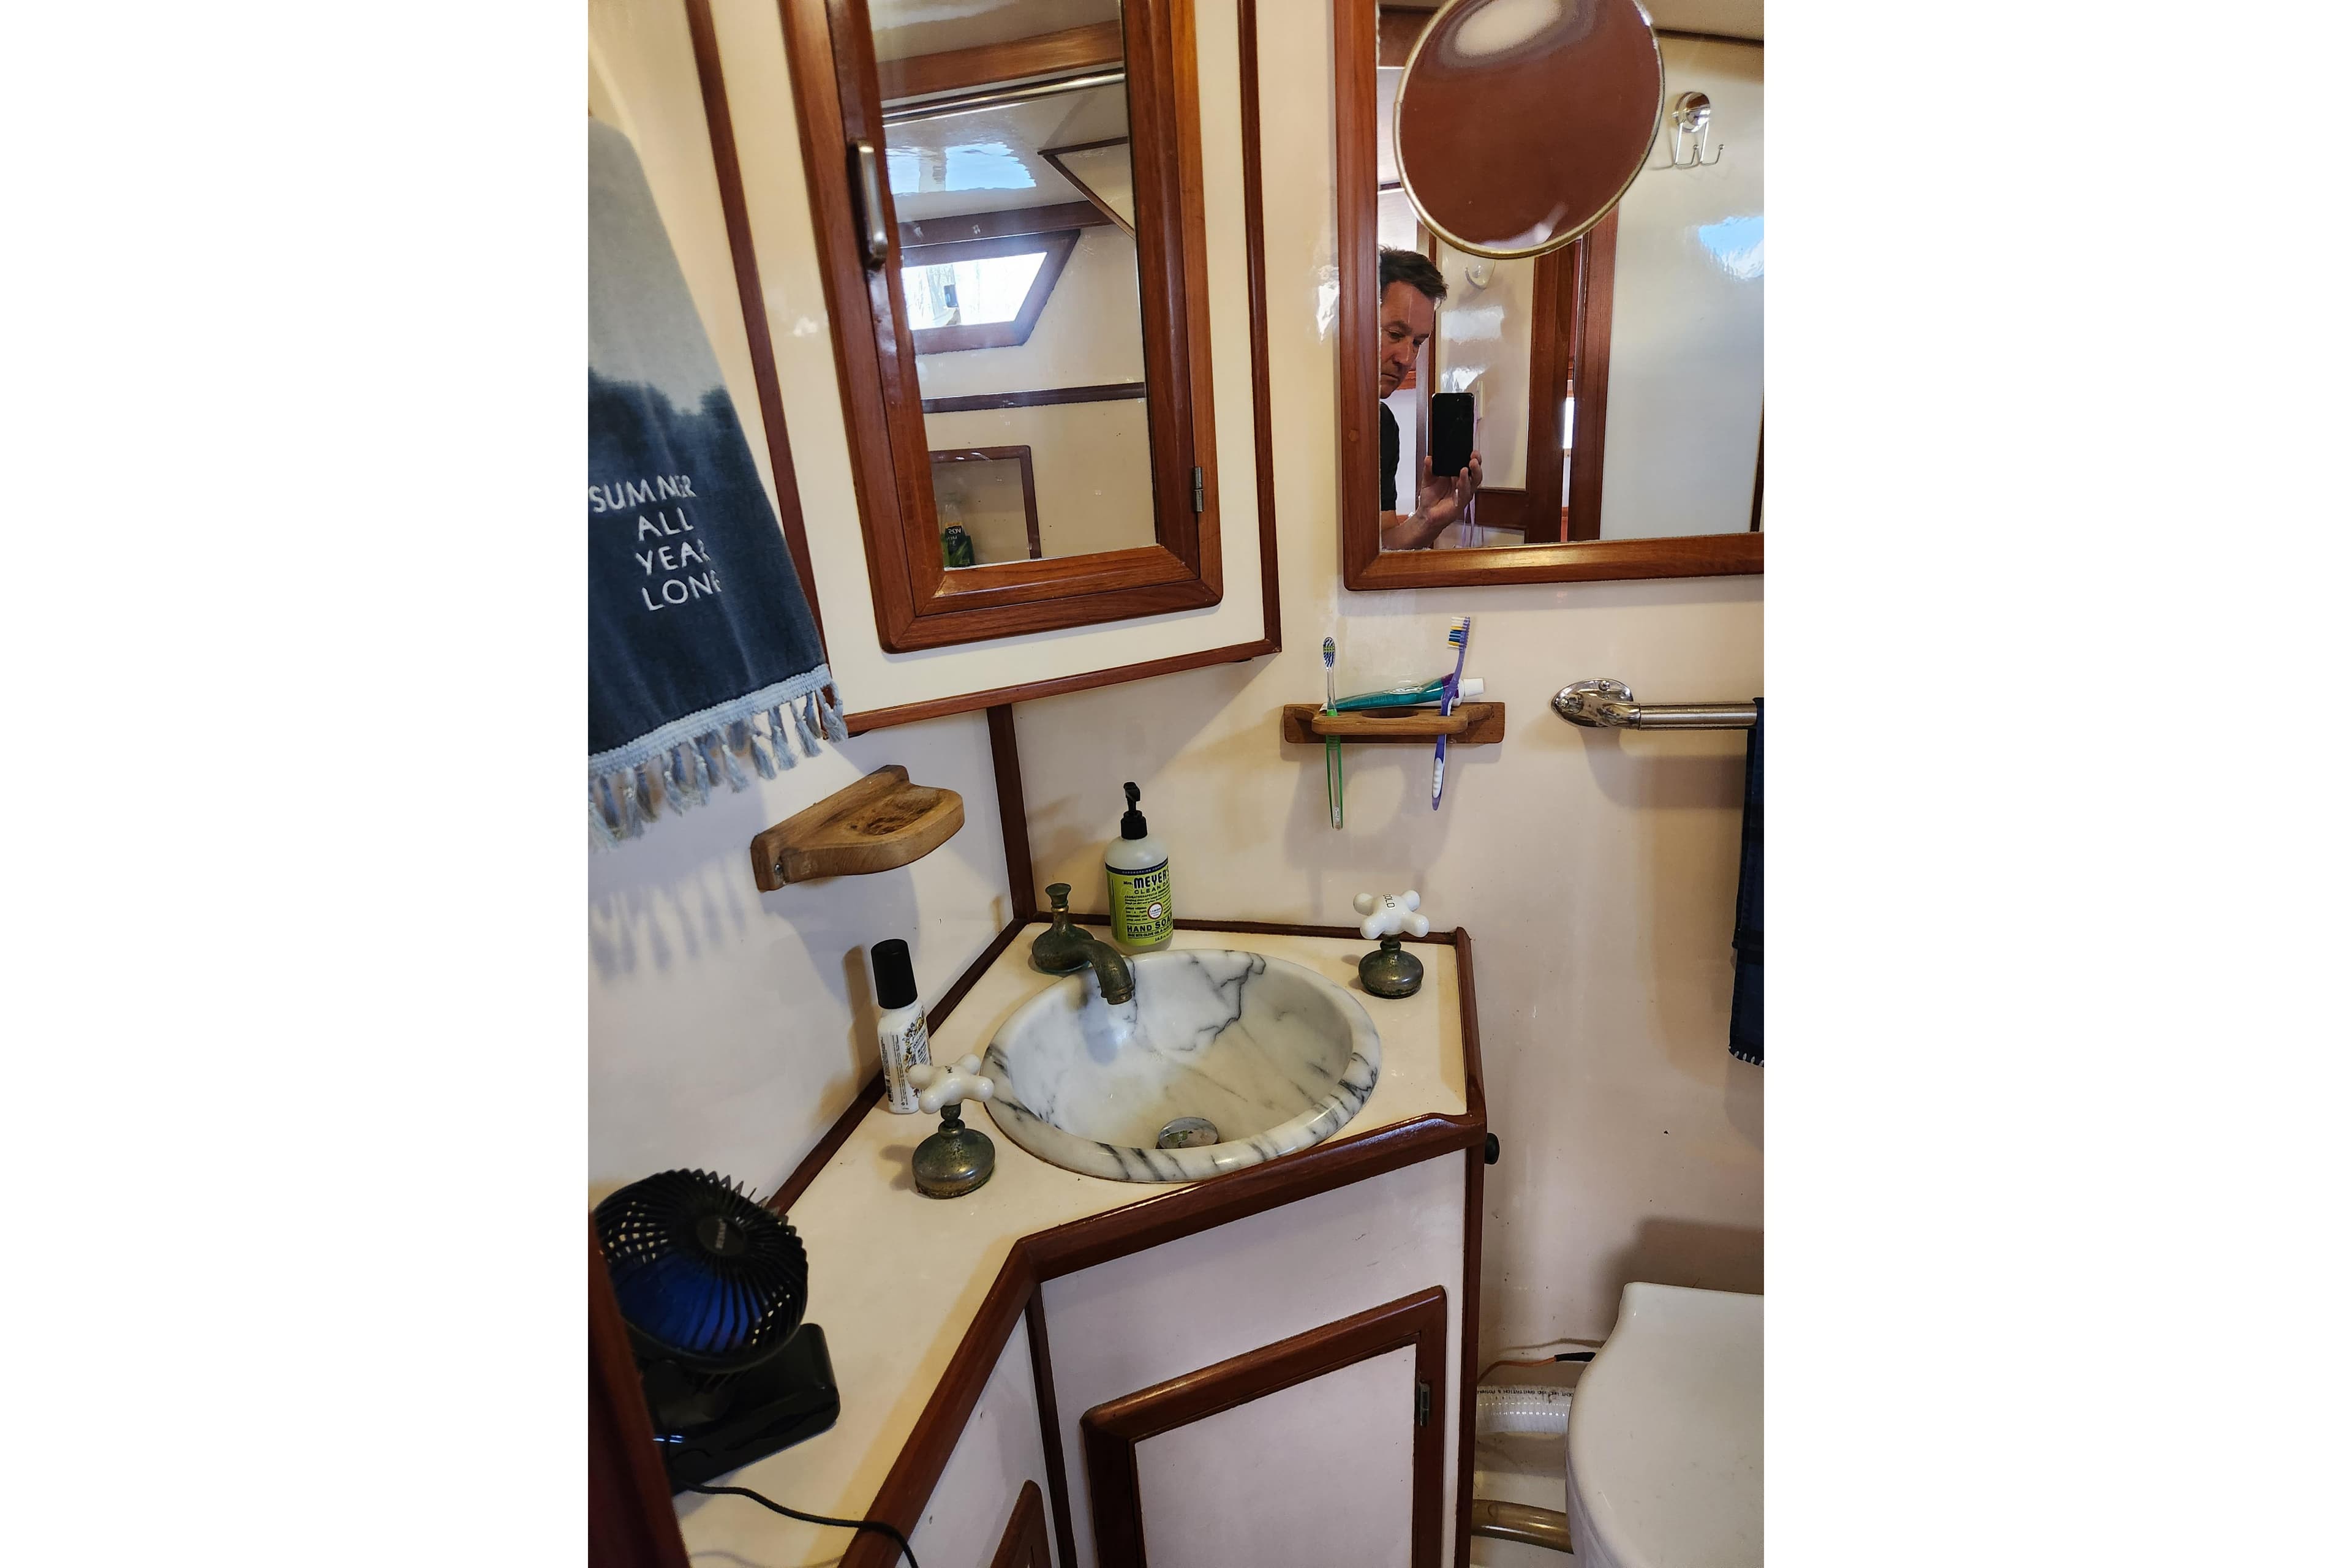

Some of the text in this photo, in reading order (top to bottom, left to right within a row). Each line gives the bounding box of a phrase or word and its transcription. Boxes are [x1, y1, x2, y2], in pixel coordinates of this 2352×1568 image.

[589, 475, 697, 513] SUMMR
[638, 507, 694, 541] ALL
[1134, 885, 1161, 895] CLEAN
